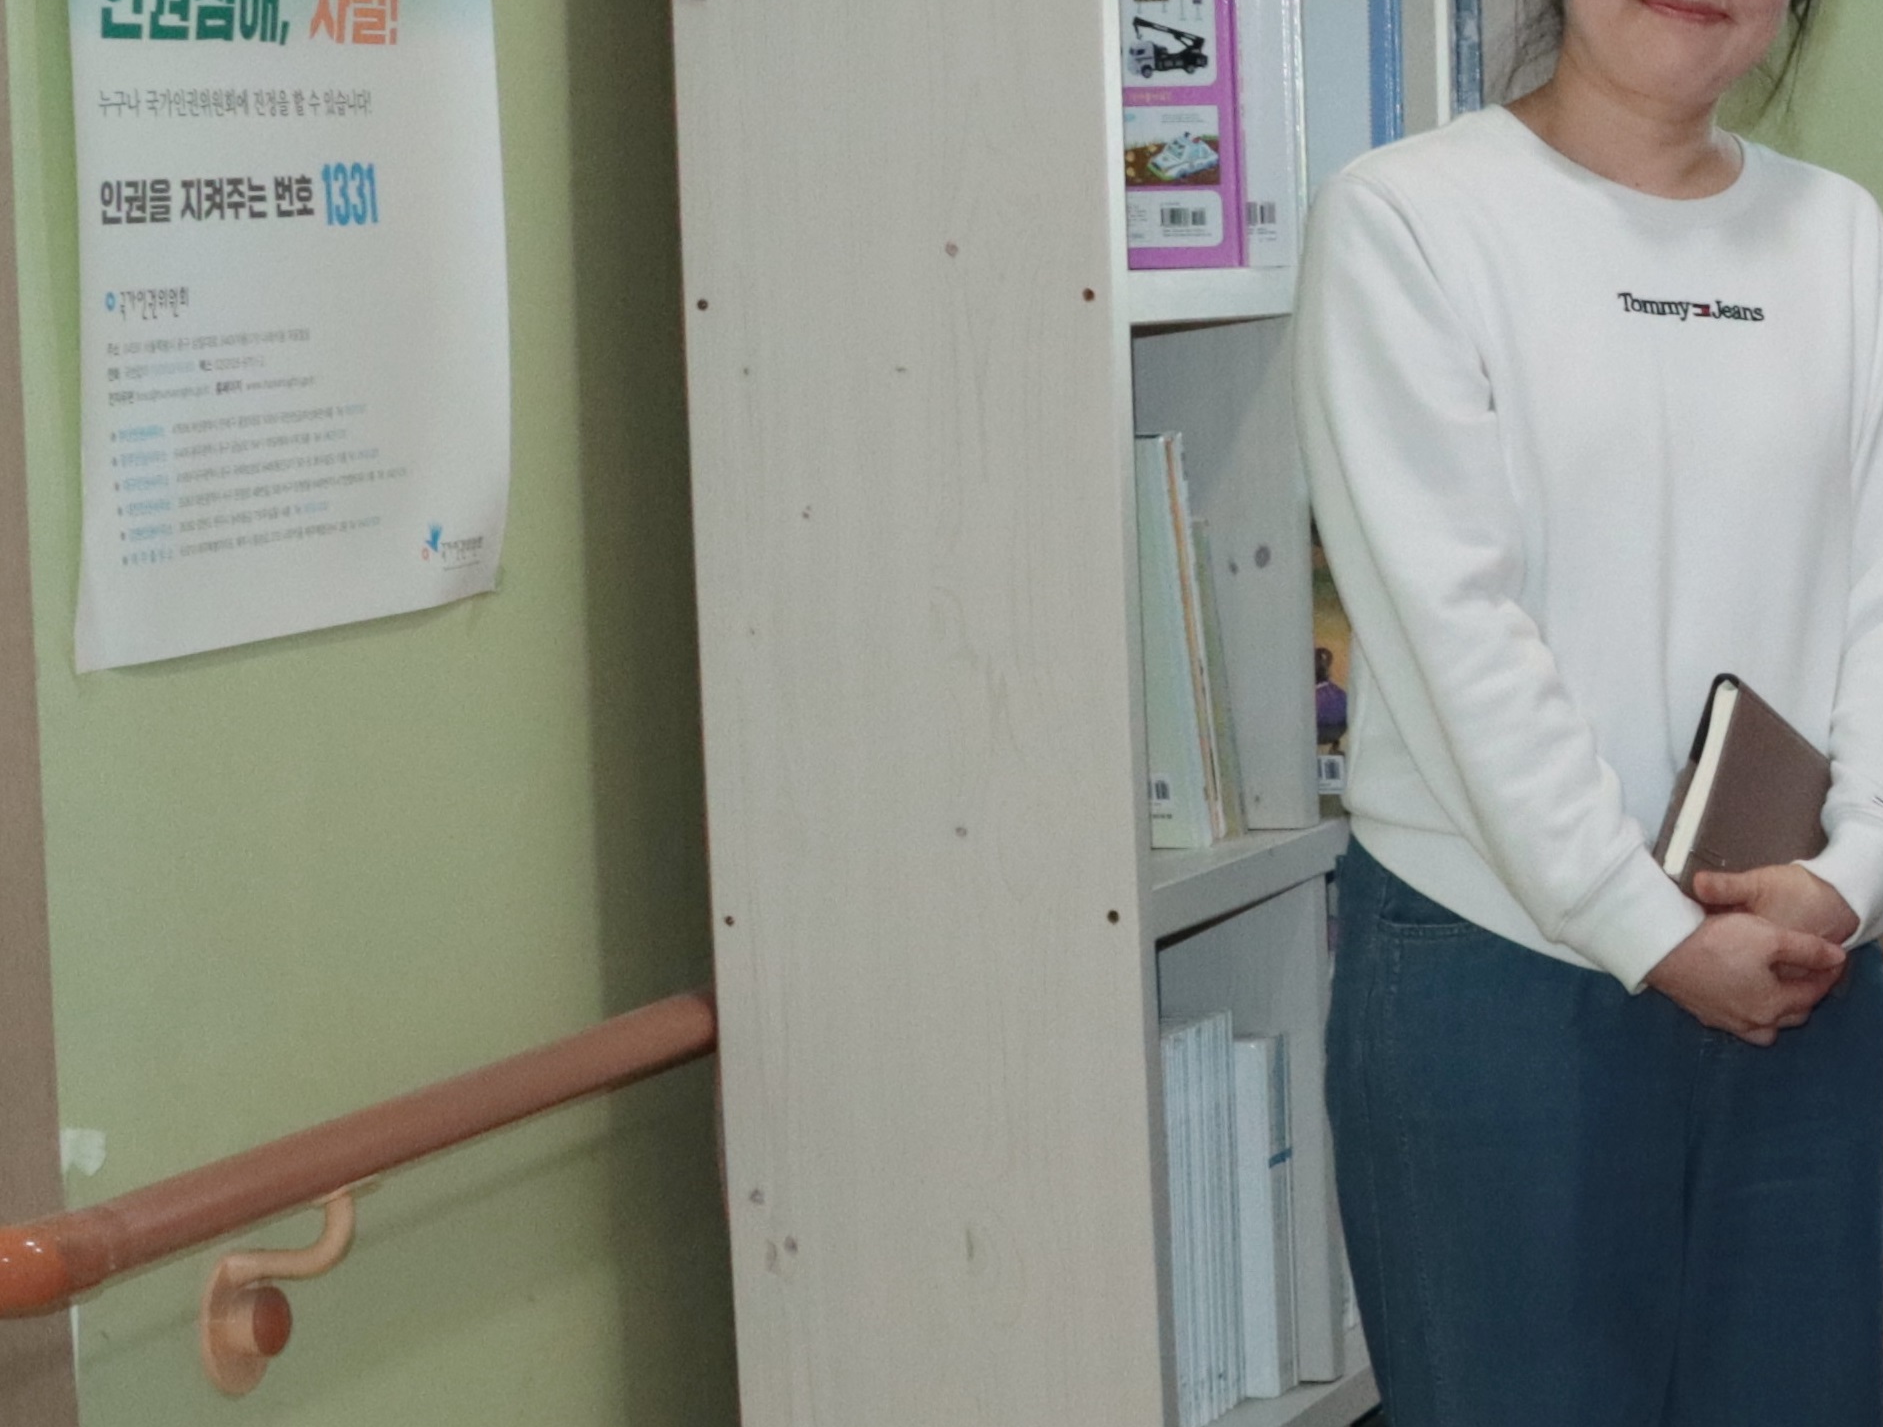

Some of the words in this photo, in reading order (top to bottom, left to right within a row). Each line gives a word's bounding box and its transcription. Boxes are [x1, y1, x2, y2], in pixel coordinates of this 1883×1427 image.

[98, 89, 140, 117] 누구나
[308, 92, 321, 115] 수
[100, 179, 171, 225] 인권을
[180, 177, 267, 221] 지켜주는
[274, 174, 315, 217] 번호
[320, 163, 378, 225] 1331
[1617, 292, 1692, 321] Tommy
[1712, 300, 1765, 321] Jeans
